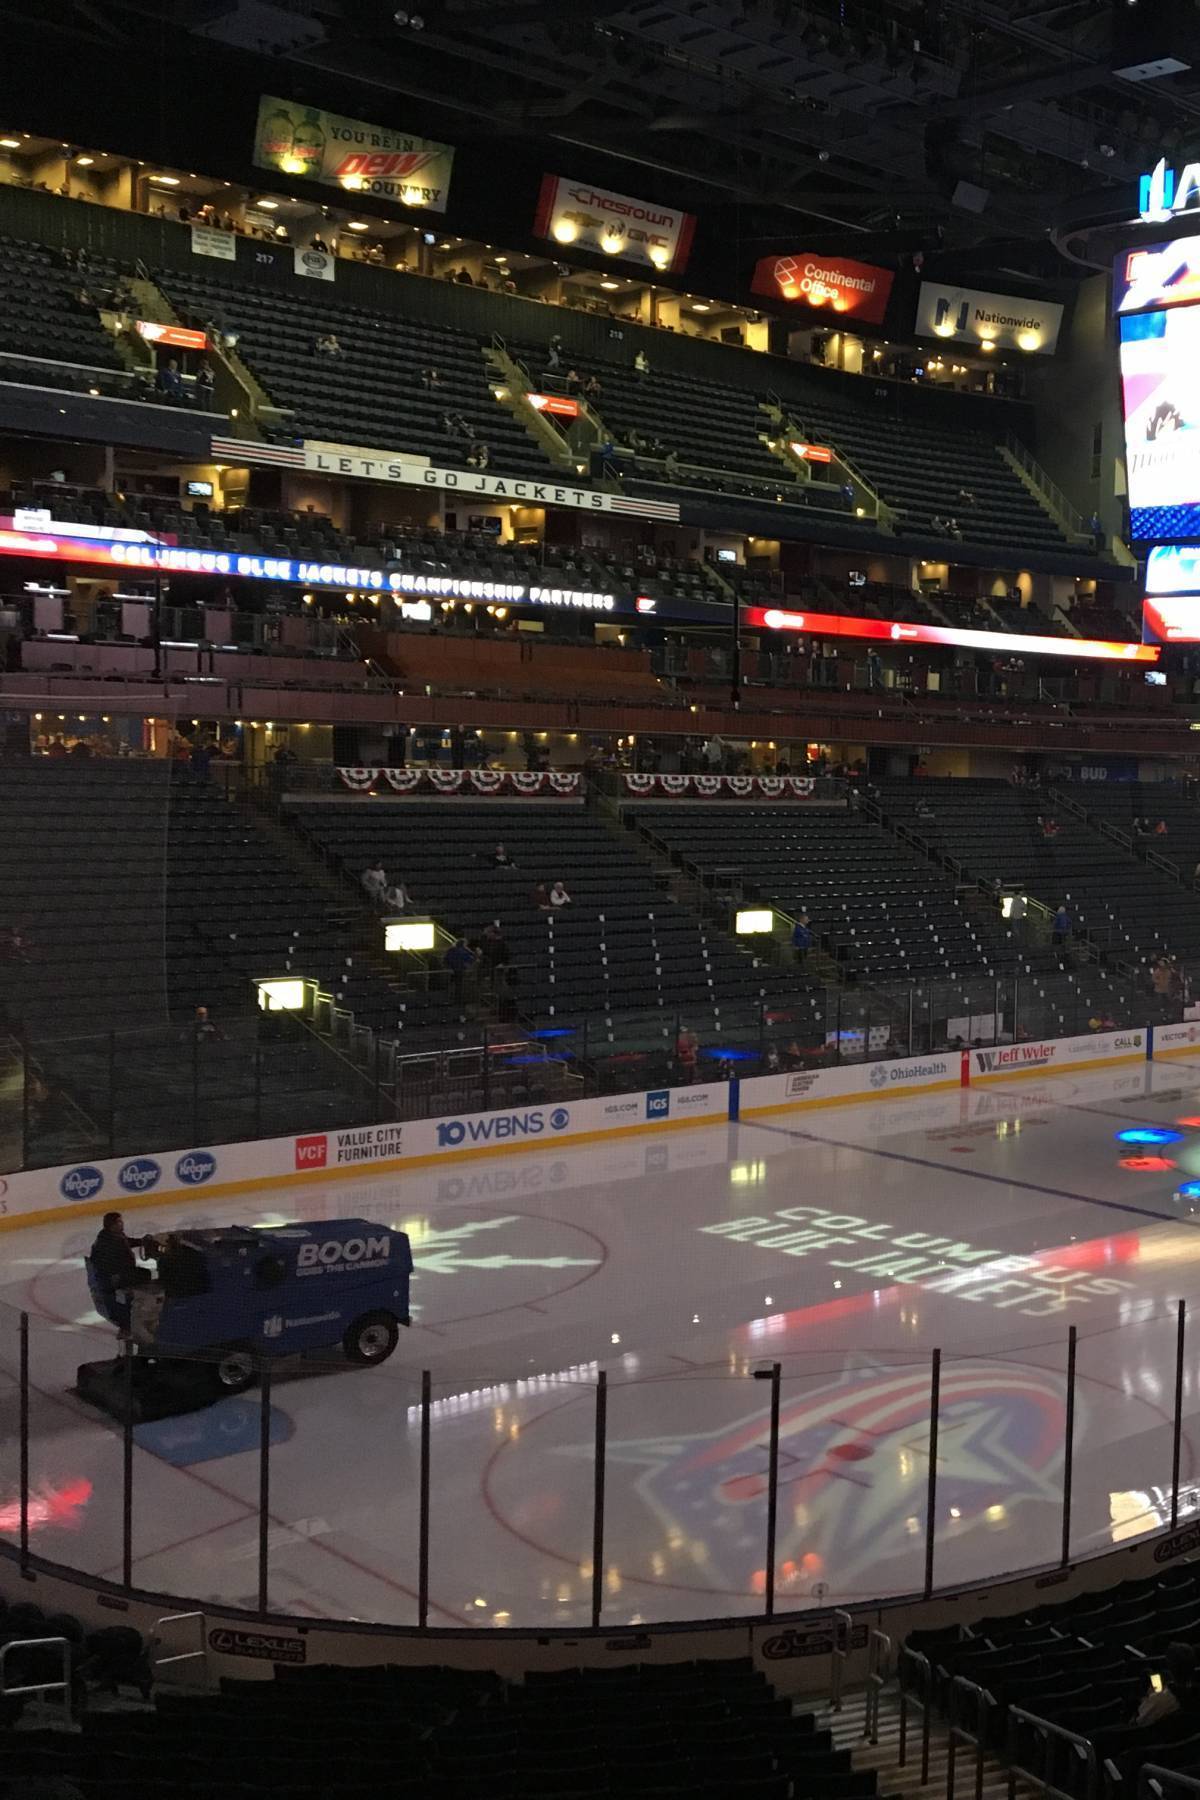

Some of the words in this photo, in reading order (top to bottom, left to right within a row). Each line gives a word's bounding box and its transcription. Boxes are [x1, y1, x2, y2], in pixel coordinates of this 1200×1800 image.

[331, 127, 392, 150] YOU'RE
[396, 139, 415, 151] IN
[361, 178, 441, 202] COUNTRY
[627, 227, 670, 248] GMC
[255, 253, 274, 265] 217
[804, 263, 876, 292] Continental
[801, 278, 839, 300] Office
[974, 309, 1041, 330] Nationwide
[317, 455, 402, 479] LET'S
[424, 471, 458, 487] GO
[475, 478, 603, 507] JACKETS
[110, 544, 229, 573] COLUMBUS
[237, 557, 291, 580] BLUE
[297, 564, 383, 588] JACKETS
[389, 573, 524, 601] CHAMPIONSHIP
[529, 587, 614, 610] PARTNERS
[1081, 767, 1107, 779] BUD
[1114, 1037, 1132, 1047] CALL
[1161, 1032, 1187, 1042] VECTOR
[997, 1047, 1018, 1065] Jeff
[1022, 1044, 1056, 1062] Wyler
[890, 1063, 946, 1081] OhioHealth
[649, 1098, 667, 1111] IGS
[337, 1130, 373, 1147] VALUE
[376, 1127, 402, 1143] CITY
[468, 1112, 544, 1141] WBNS
[298, 1145, 326, 1161] VCF
[337, 1143, 401, 1162] FURNITURE
[122, 1165, 157, 1188] Kroger
[179, 1157, 213, 1181] Kroger
[65, 1173, 100, 1196] Kroger
[297, 1236, 391, 1267] BOOM
[774, 1206, 1138, 1296] COLUMBUS
[327, 1263, 345, 1272] THE
[698, 1216, 857, 1256] BLUE
[829, 1251, 1093, 1318] JACKETS
[234, 1633, 304, 1651] LEXUS
